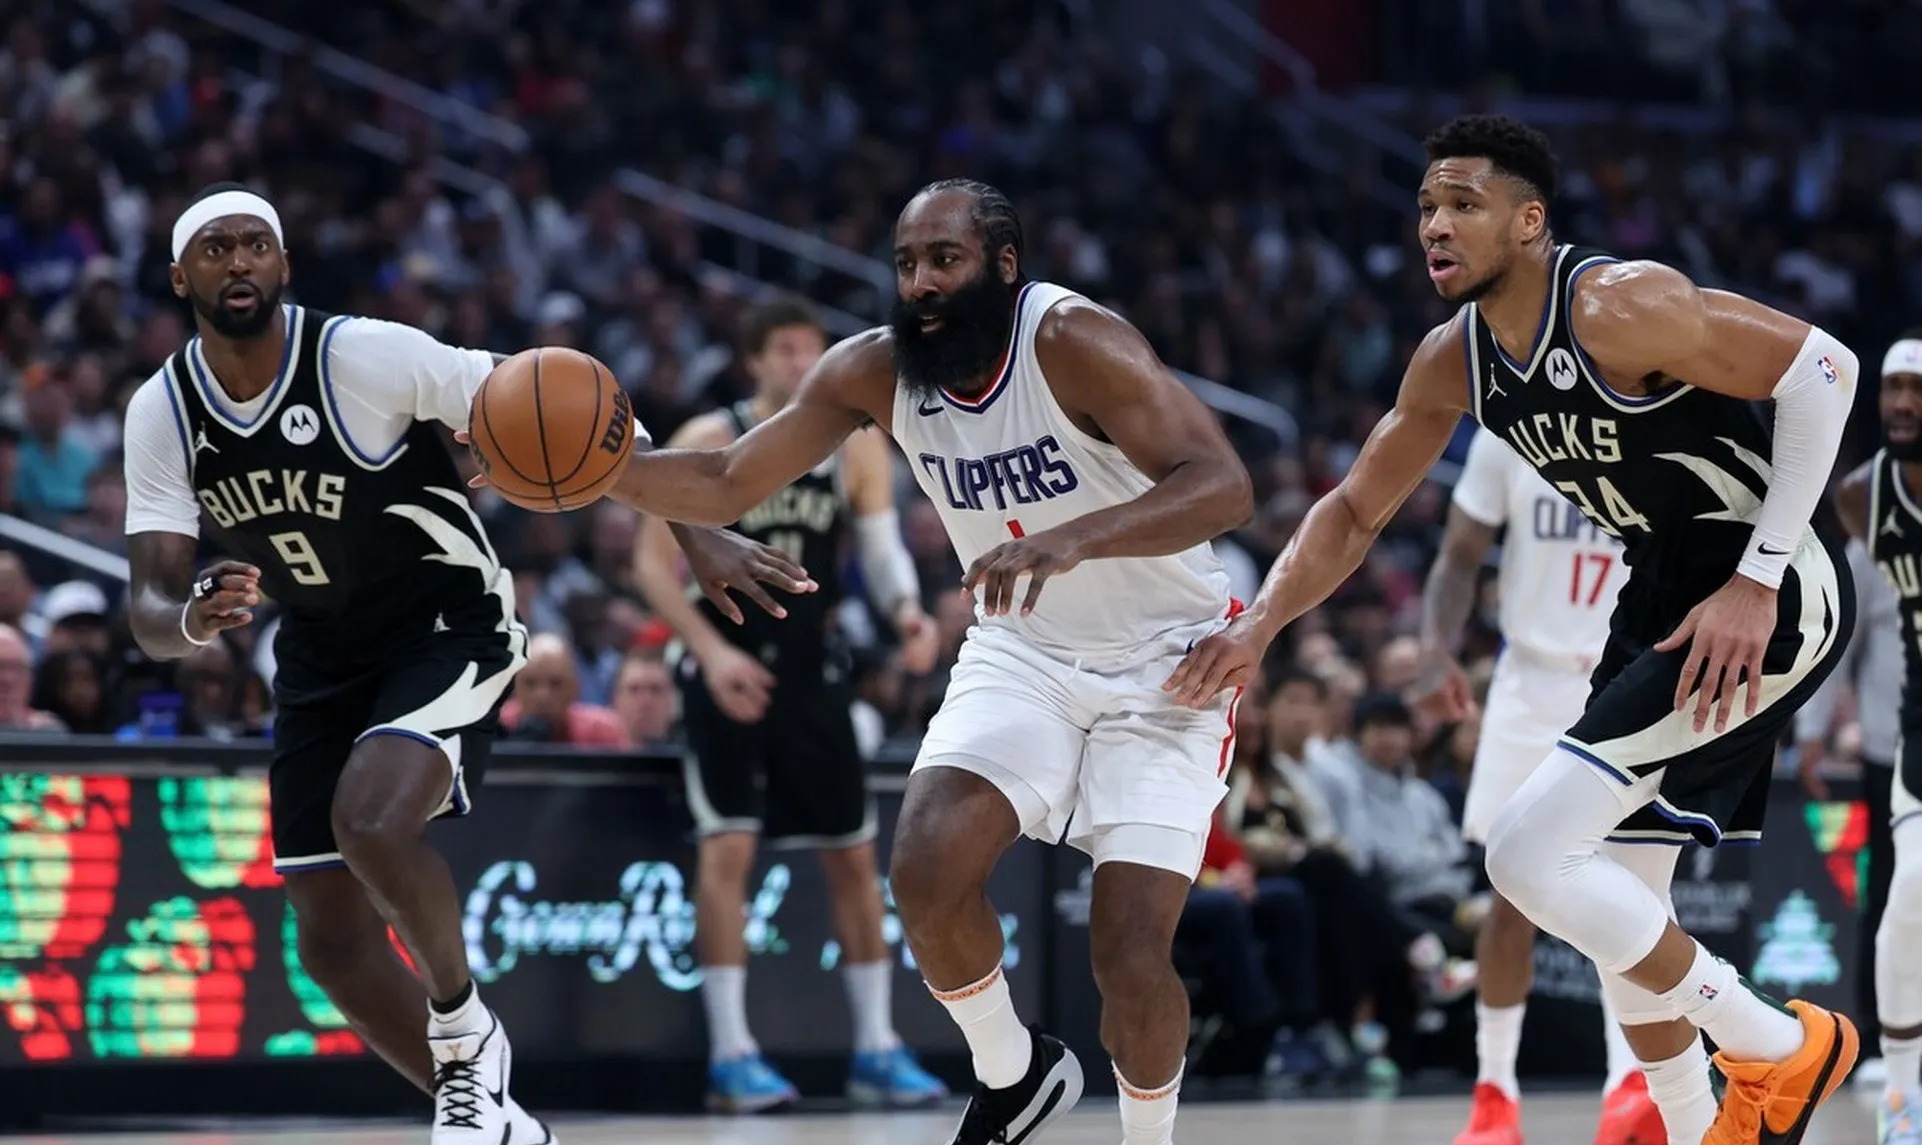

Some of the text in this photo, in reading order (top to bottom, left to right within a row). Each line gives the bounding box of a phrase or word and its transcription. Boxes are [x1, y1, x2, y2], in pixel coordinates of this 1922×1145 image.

[1508, 412, 1624, 469] UCKS
[198, 468, 346, 529] BUCKS
[1555, 475, 1652, 537] 34
[268, 531, 330, 585] 9
[1568, 551, 1615, 609] 17
